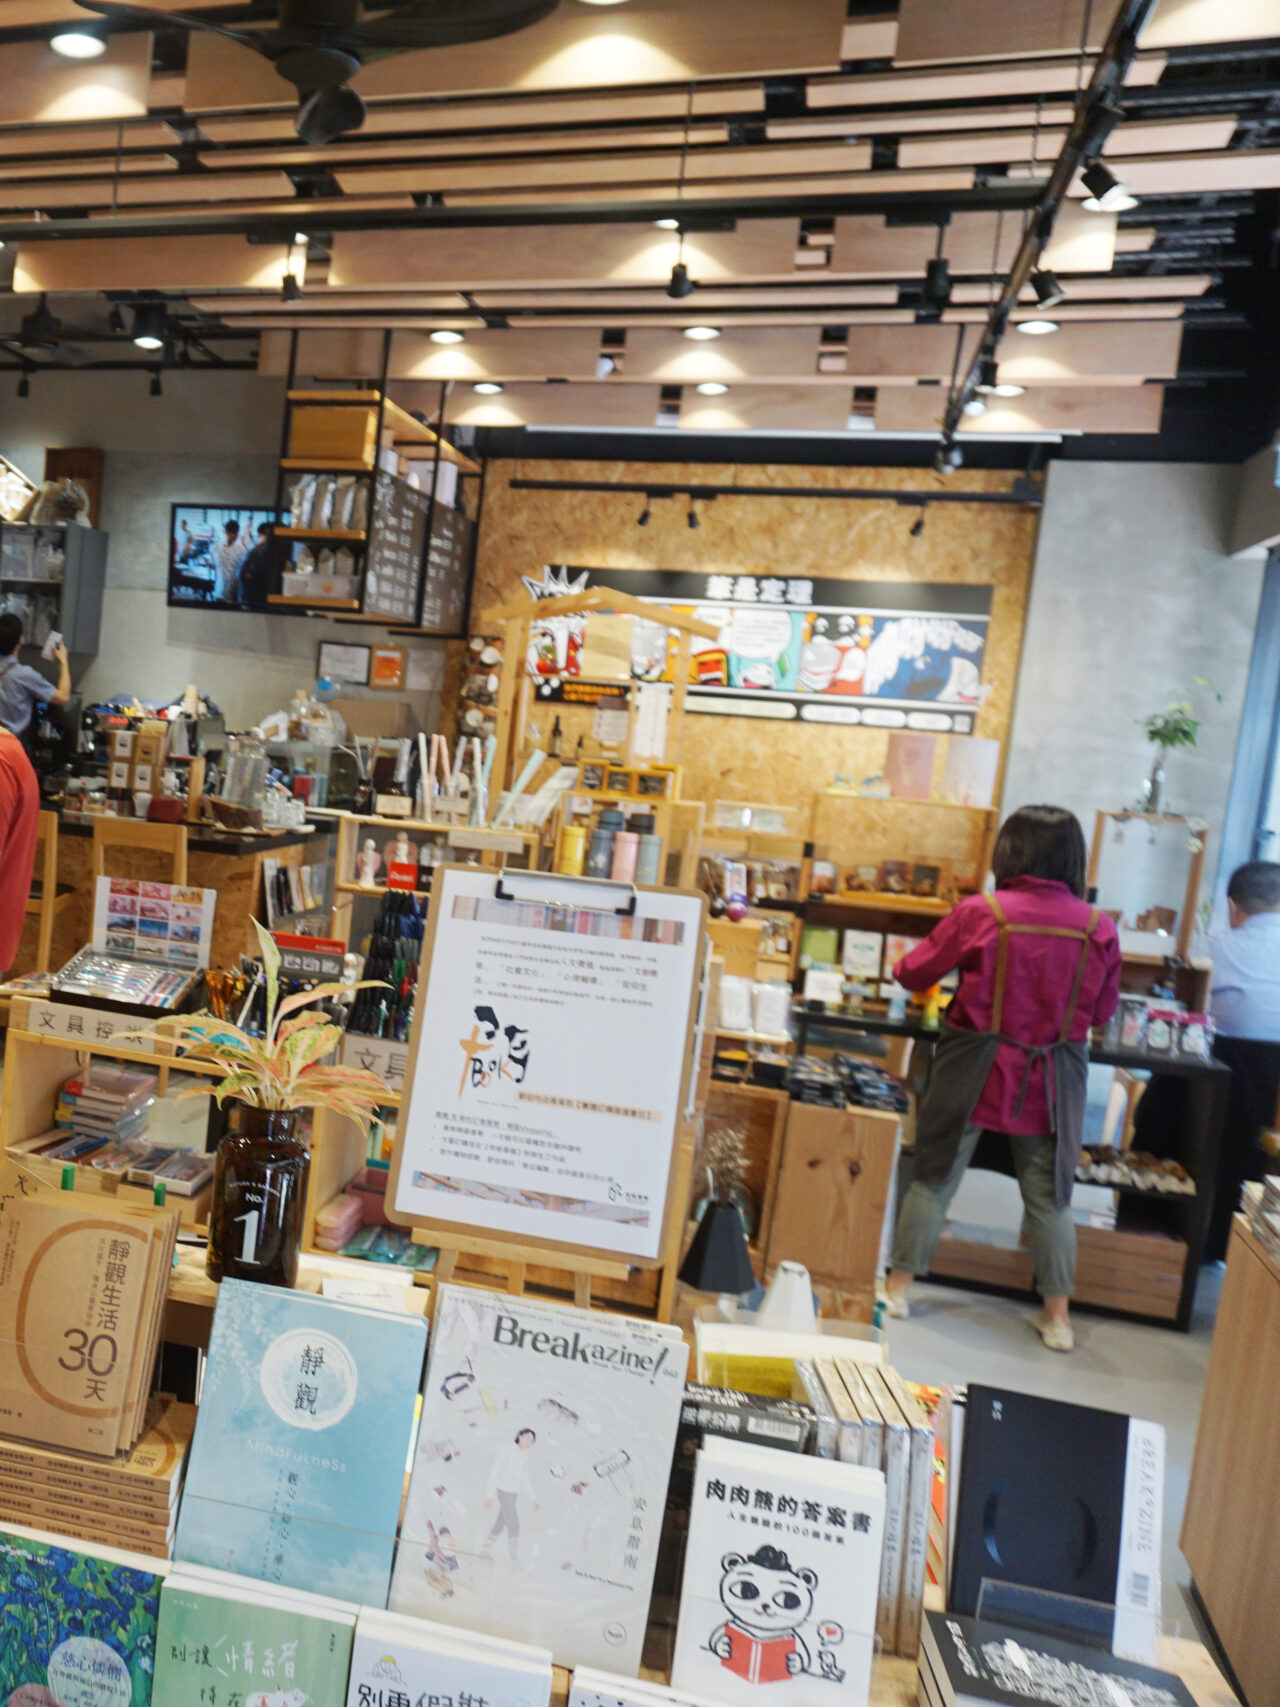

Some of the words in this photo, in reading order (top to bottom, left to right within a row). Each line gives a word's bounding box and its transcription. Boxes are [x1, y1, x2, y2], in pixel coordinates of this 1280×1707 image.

[233, 1209, 261, 1265] 1
[96, 1239, 131, 1333] 靜觀生活
[57, 1328, 118, 1377] 30
[493, 1314, 669, 1385] Breakazine!
[83, 1377, 108, 1402] 天
[294, 1344, 325, 1416] 靜觀
[706, 1478, 872, 1534] 肉肉熊的答案書
